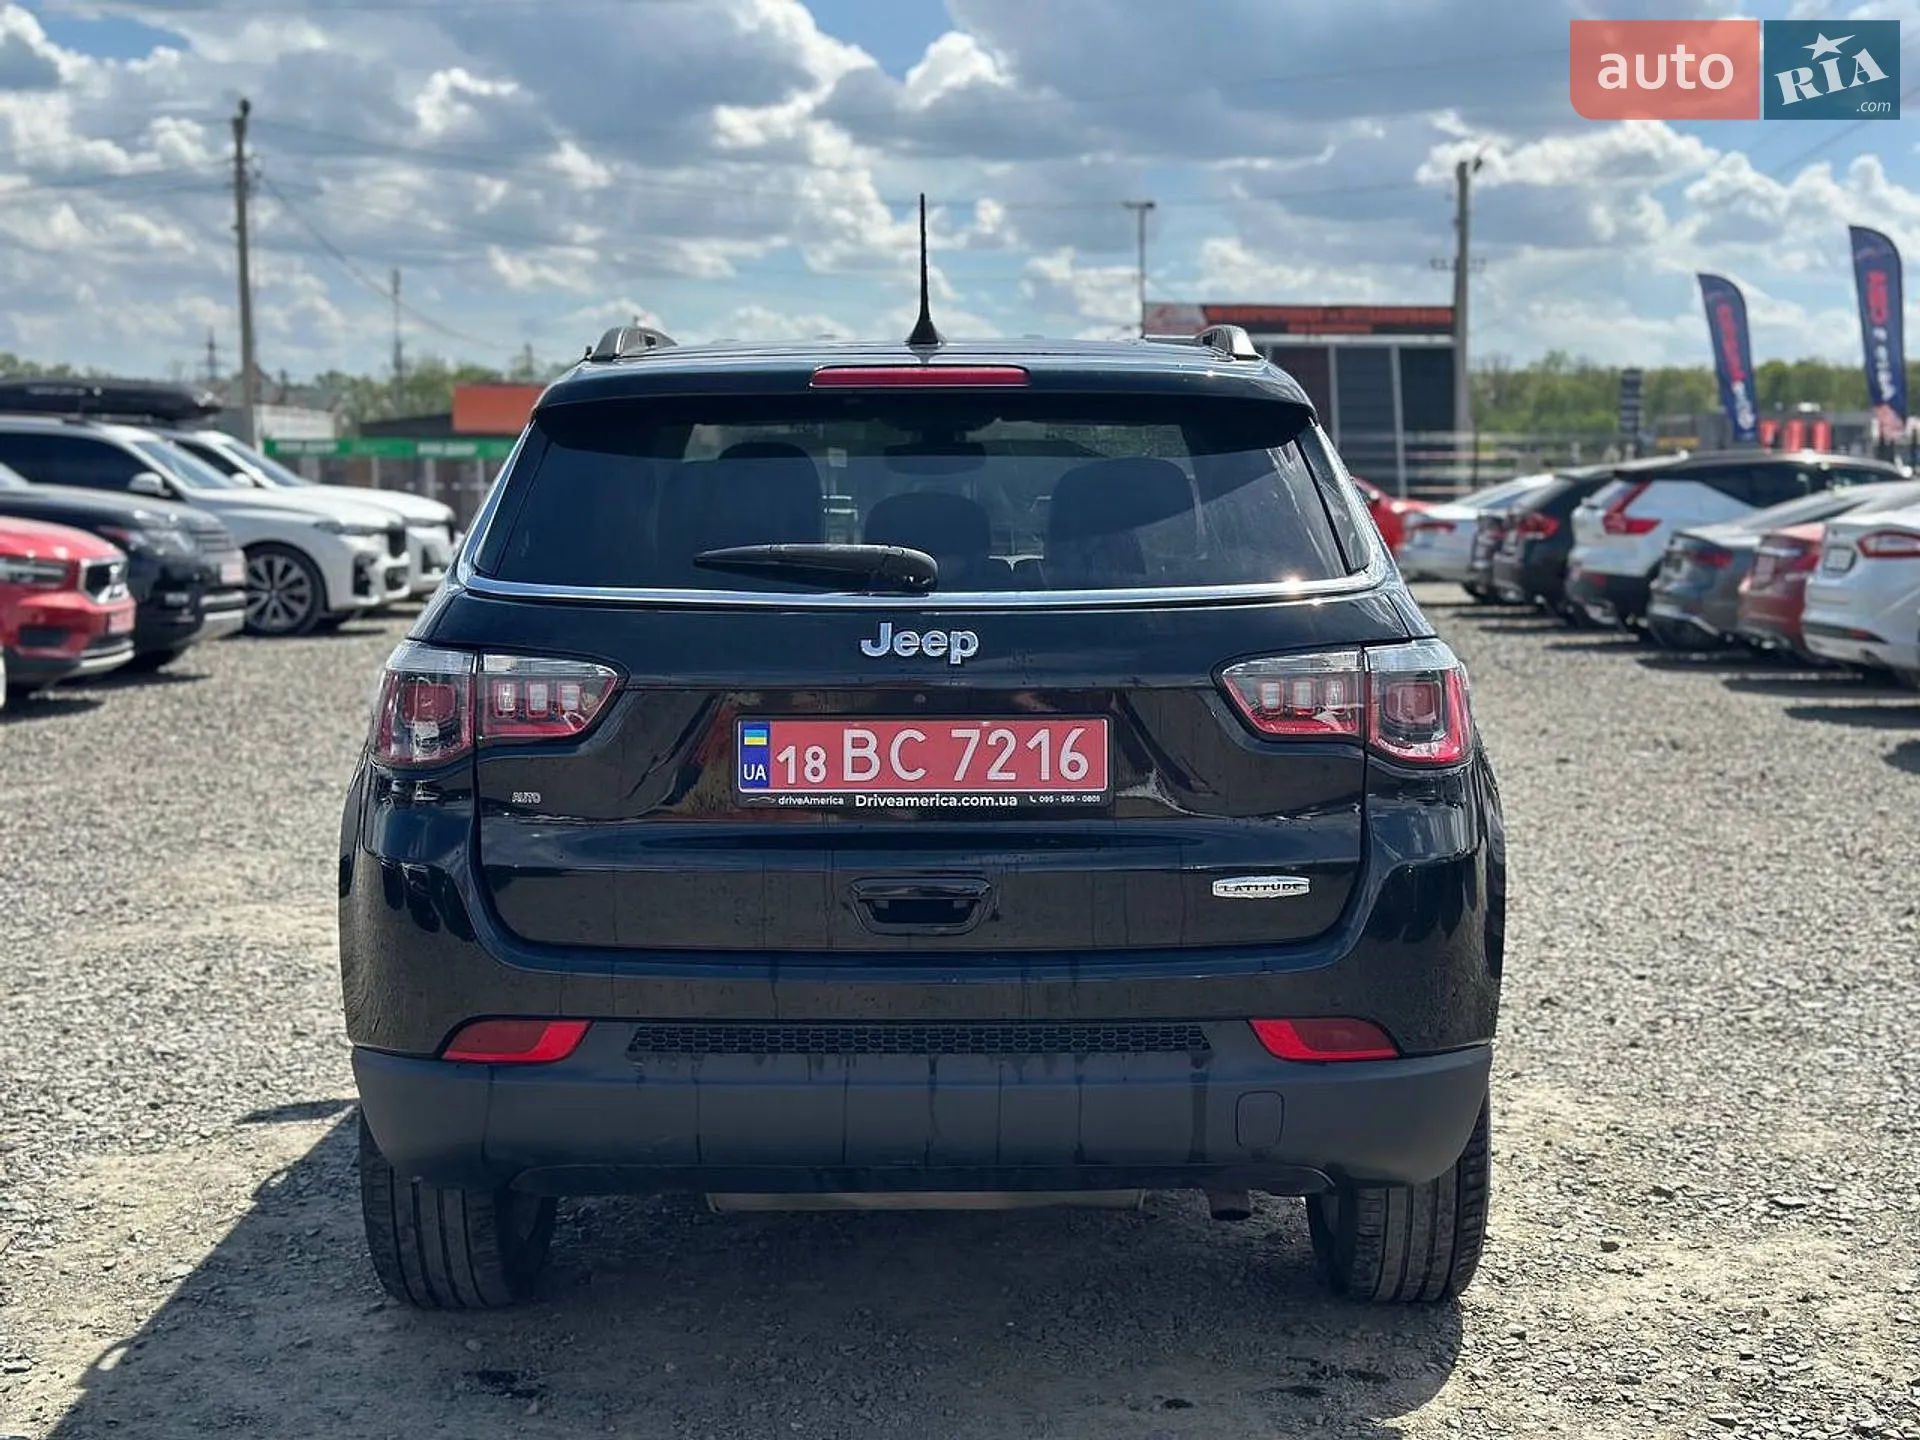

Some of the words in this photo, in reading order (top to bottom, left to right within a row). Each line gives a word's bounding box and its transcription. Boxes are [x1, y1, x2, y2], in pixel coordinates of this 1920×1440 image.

[860, 622, 979, 664] Jeep
[776, 745, 827, 784] 18
[843, 728, 927, 782] BC
[950, 728, 1089, 782] 7216
[743, 764, 767, 781] UA
[778, 795, 844, 806] driveAmerica
[855, 794, 1018, 808] Driveamerica.com.ua
[1223, 883, 1302, 892] LATITUDE
